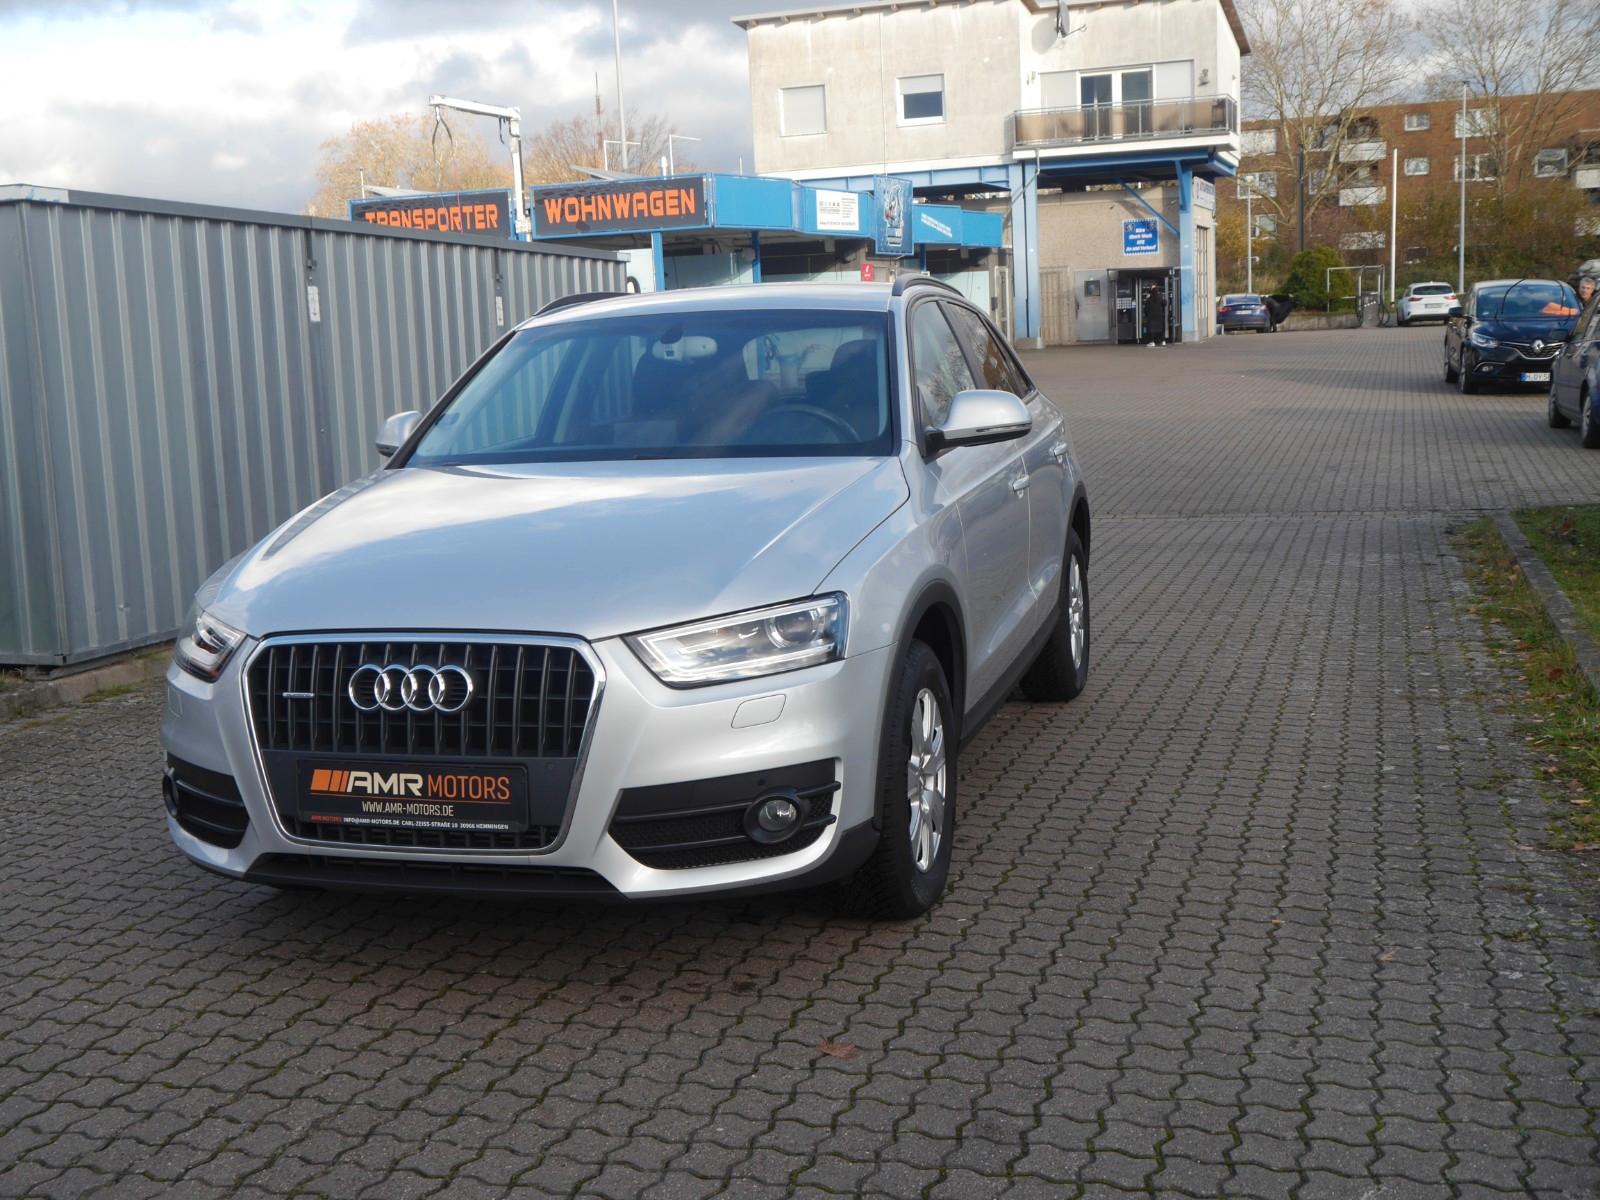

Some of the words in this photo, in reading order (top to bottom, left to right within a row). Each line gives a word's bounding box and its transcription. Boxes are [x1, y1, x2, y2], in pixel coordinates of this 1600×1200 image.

[365, 203, 498, 231] TRANSPORTER
[544, 188, 696, 224] WOHNWAGEN
[346, 771, 424, 796] AMR
[427, 774, 511, 800] MOTORS
[361, 801, 455, 817] WWW.AMR-MOTORS.DE
